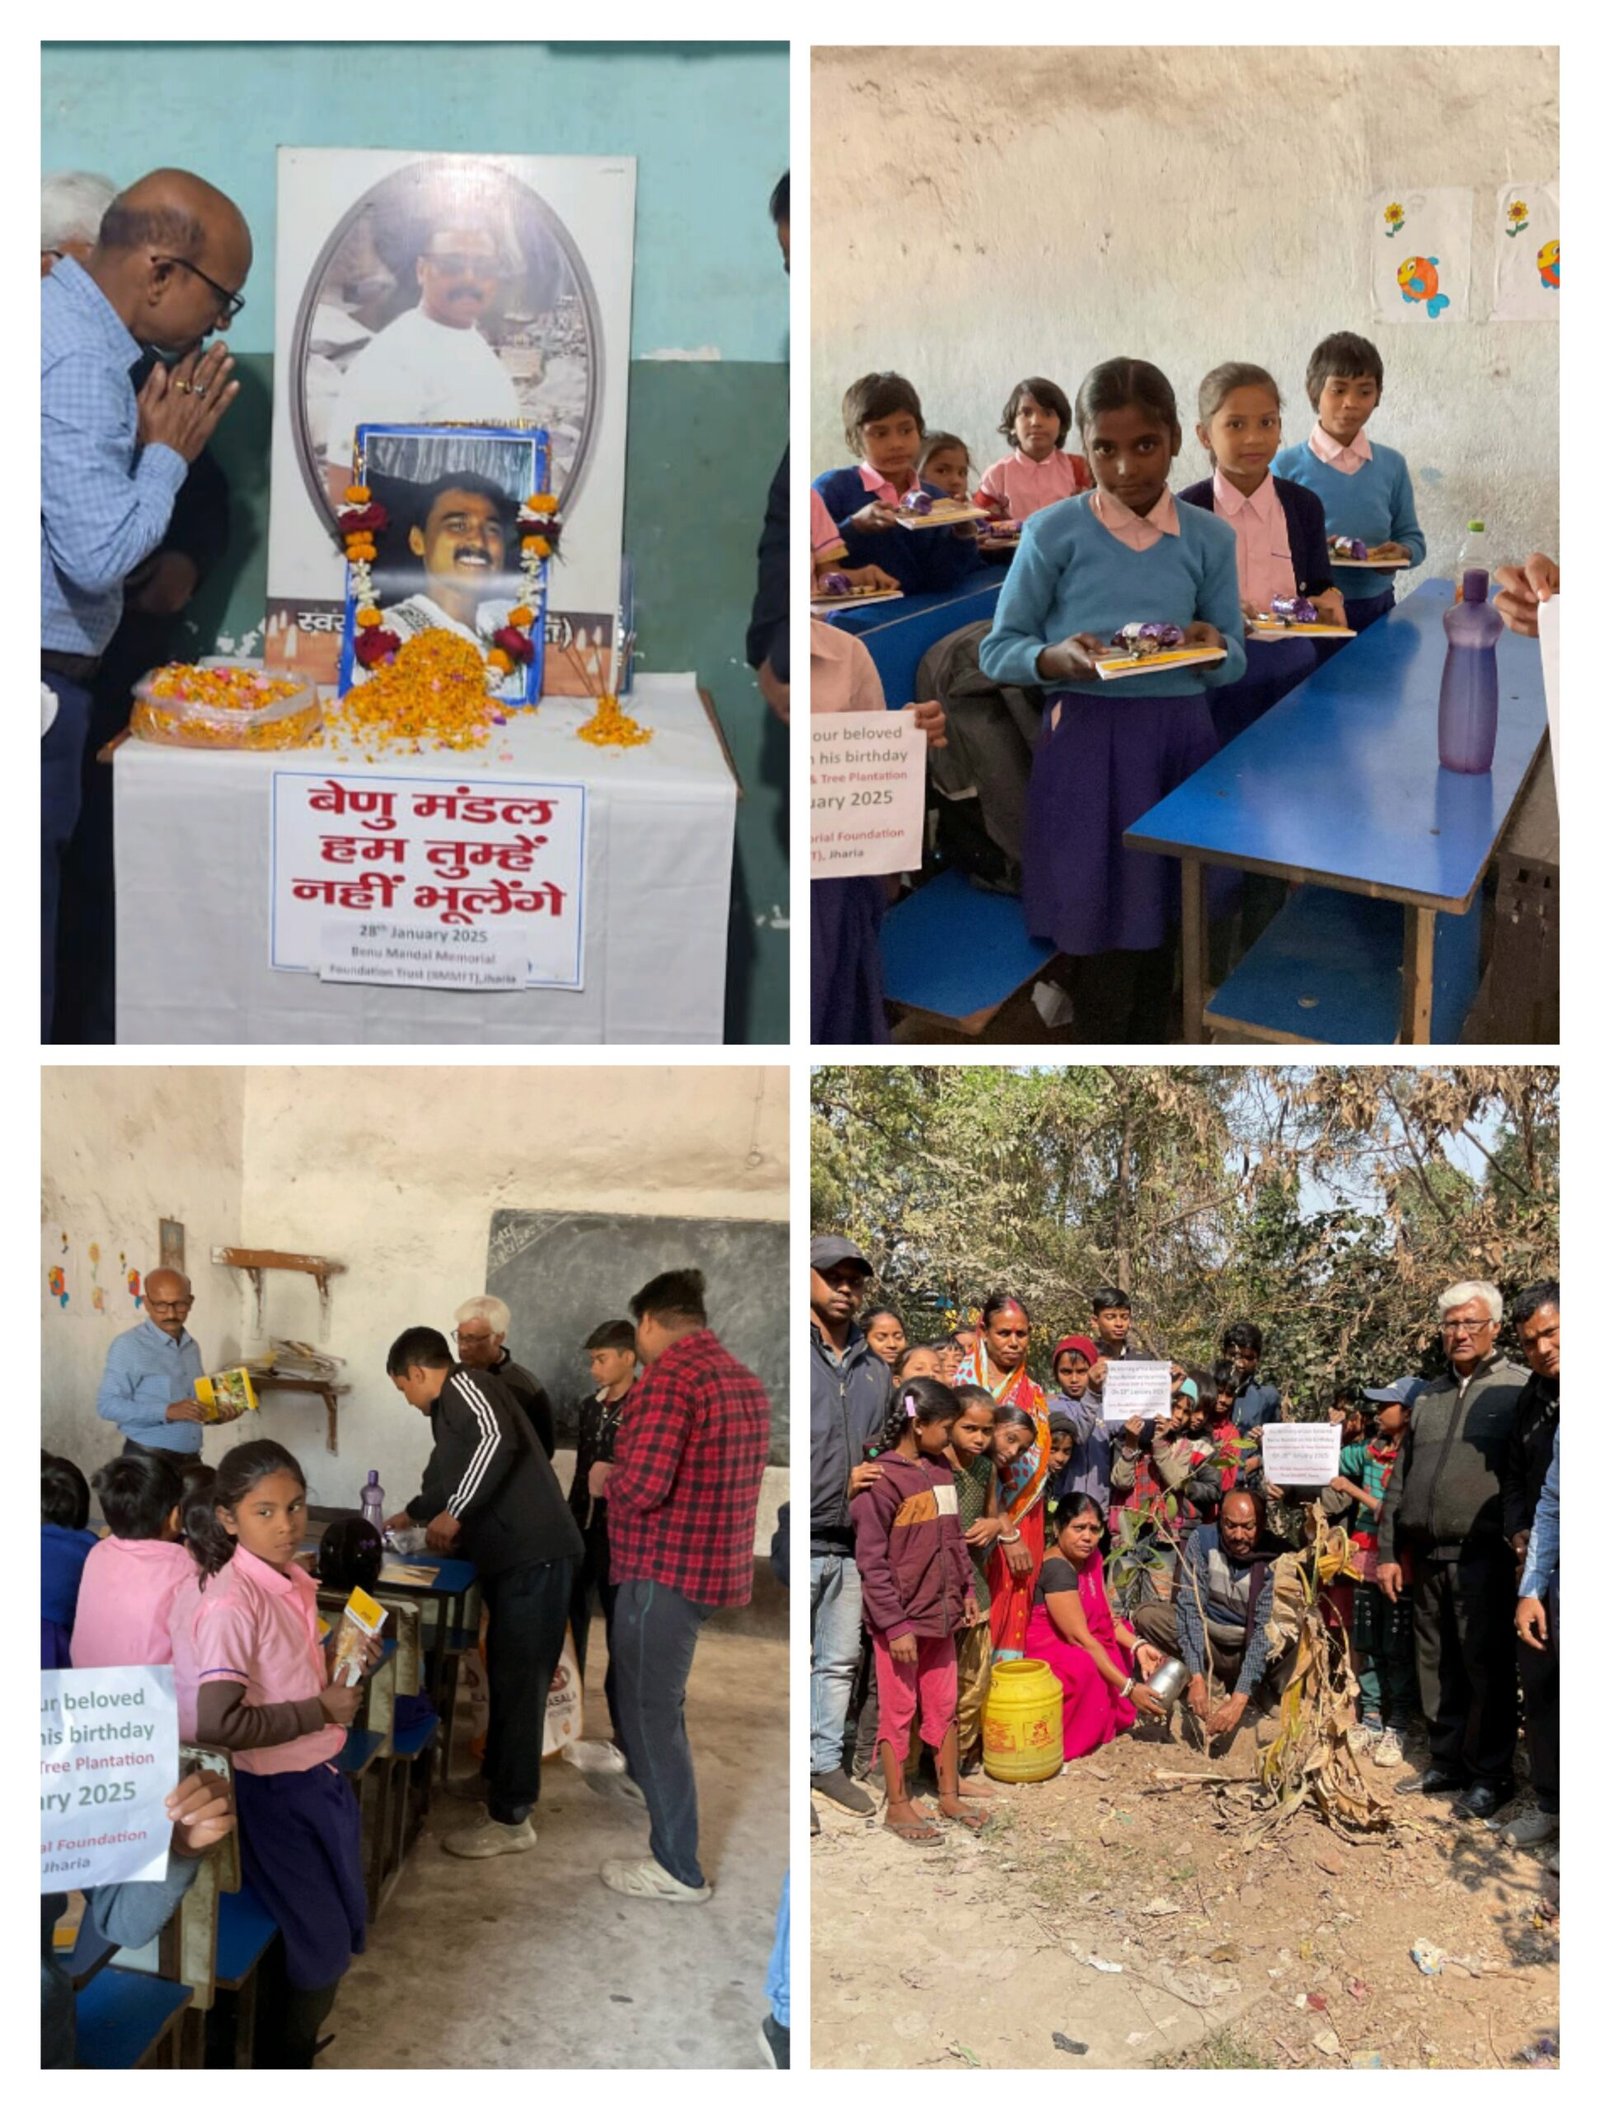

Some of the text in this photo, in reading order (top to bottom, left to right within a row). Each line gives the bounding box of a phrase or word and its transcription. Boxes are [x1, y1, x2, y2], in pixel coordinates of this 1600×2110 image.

[812, 727, 902, 742] our beloved
[820, 751, 841, 764] his
[845, 749, 908, 763] birthday
[821, 774, 846, 784] Tree
[849, 771, 907, 782] Plantation
[307, 780, 559, 831] बेणु मंडल
[851, 790, 893, 806] 2025
[838, 828, 905, 842] Foundation
[319, 834, 548, 880] हम तुम्हें
[829, 849, 864, 860] Jharia
[292, 872, 567, 925] नहीं भूलेंगे
[390, 927, 449, 942] January
[452, 929, 488, 943] 2025
[351, 946, 496, 964] Benu Mandal Memorial
[330, 964, 393, 977] Foundation
[397, 969, 424, 980] Trust
[64, 1688, 145, 1710] beloved
[70, 1722, 155, 1743] birthday
[75, 1753, 155, 1771] Plantation
[78, 1781, 136, 1806] 2025
[57, 1829, 147, 1851] Foundation
[43, 1857, 91, 1873] Jharia
